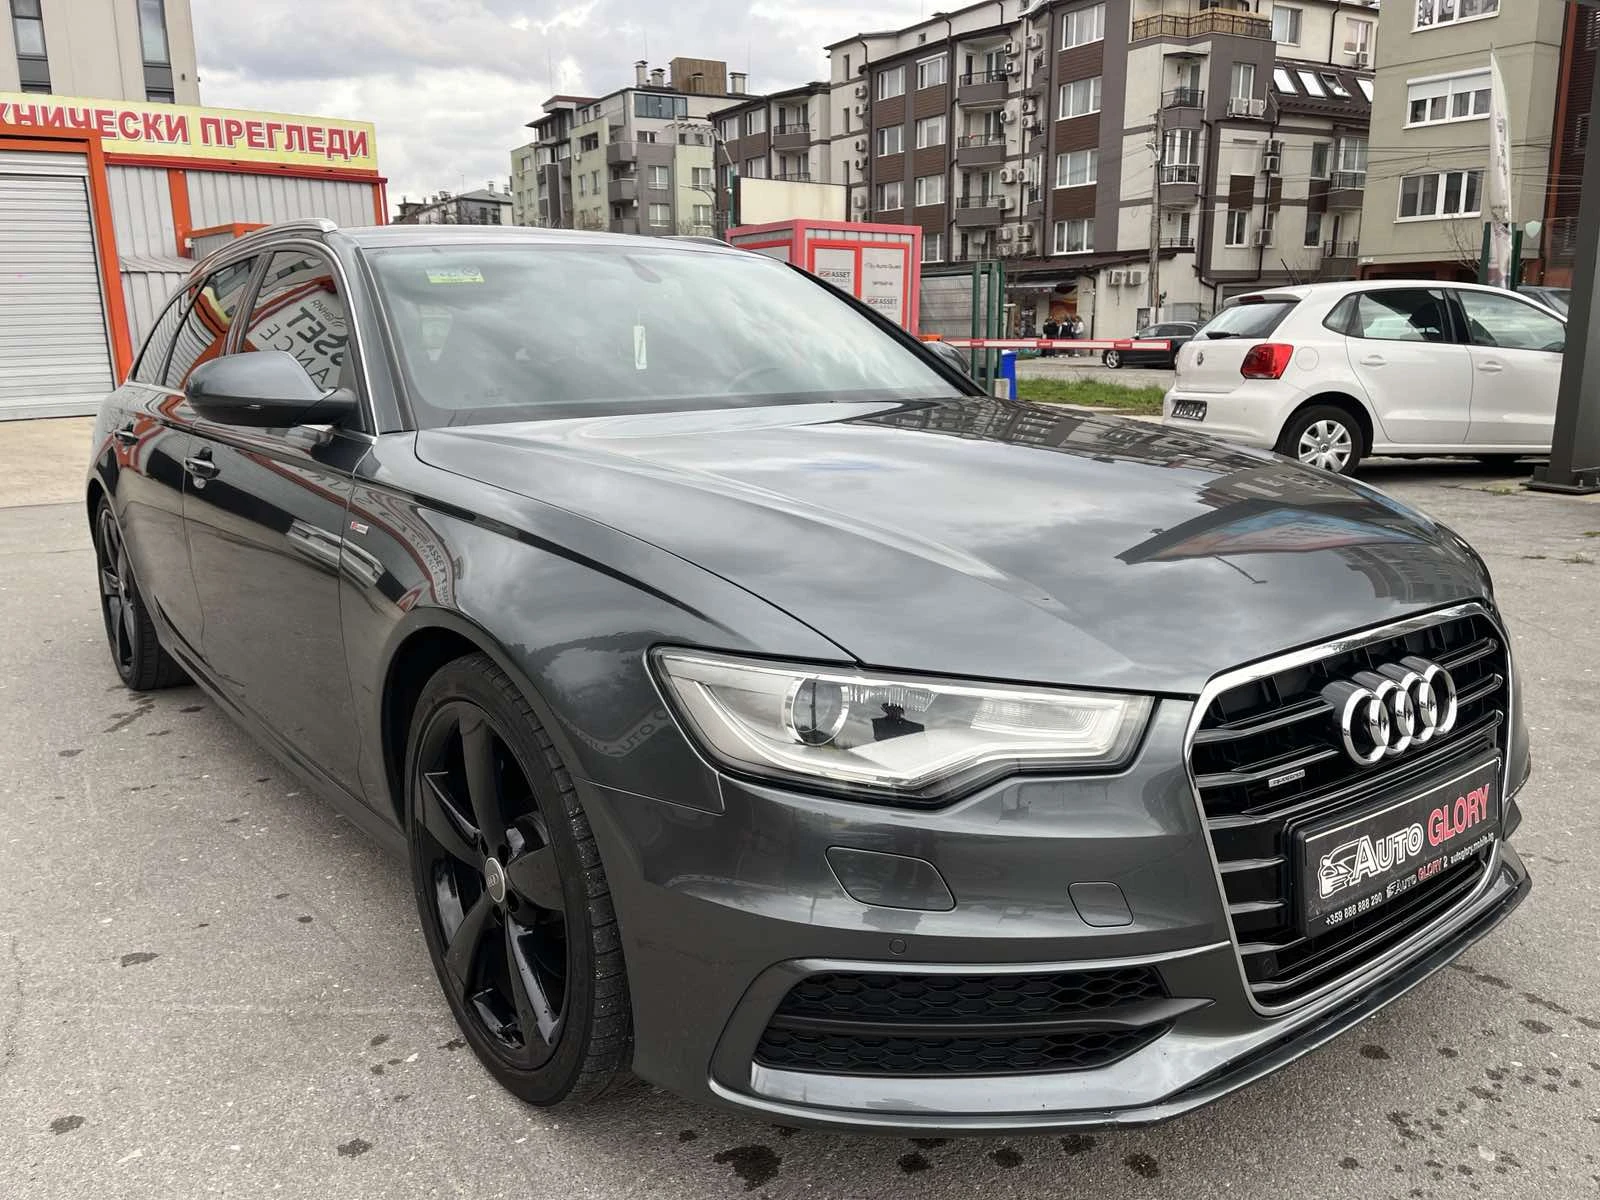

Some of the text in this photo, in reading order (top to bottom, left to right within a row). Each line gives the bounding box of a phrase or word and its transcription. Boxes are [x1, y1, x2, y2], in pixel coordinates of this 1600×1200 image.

[200, 117, 370, 161] ПРЕГЛЕДИ
[1428, 783, 1490, 847] GLORY
[1325, 910, 1343, 926] +359
[1344, 904, 1357, 919] 888
[1357, 898, 1370, 913] 888
[1370, 892, 1383, 906] 290
[1417, 857, 1443, 880] GLORY
[1443, 855, 1448, 868] 2
